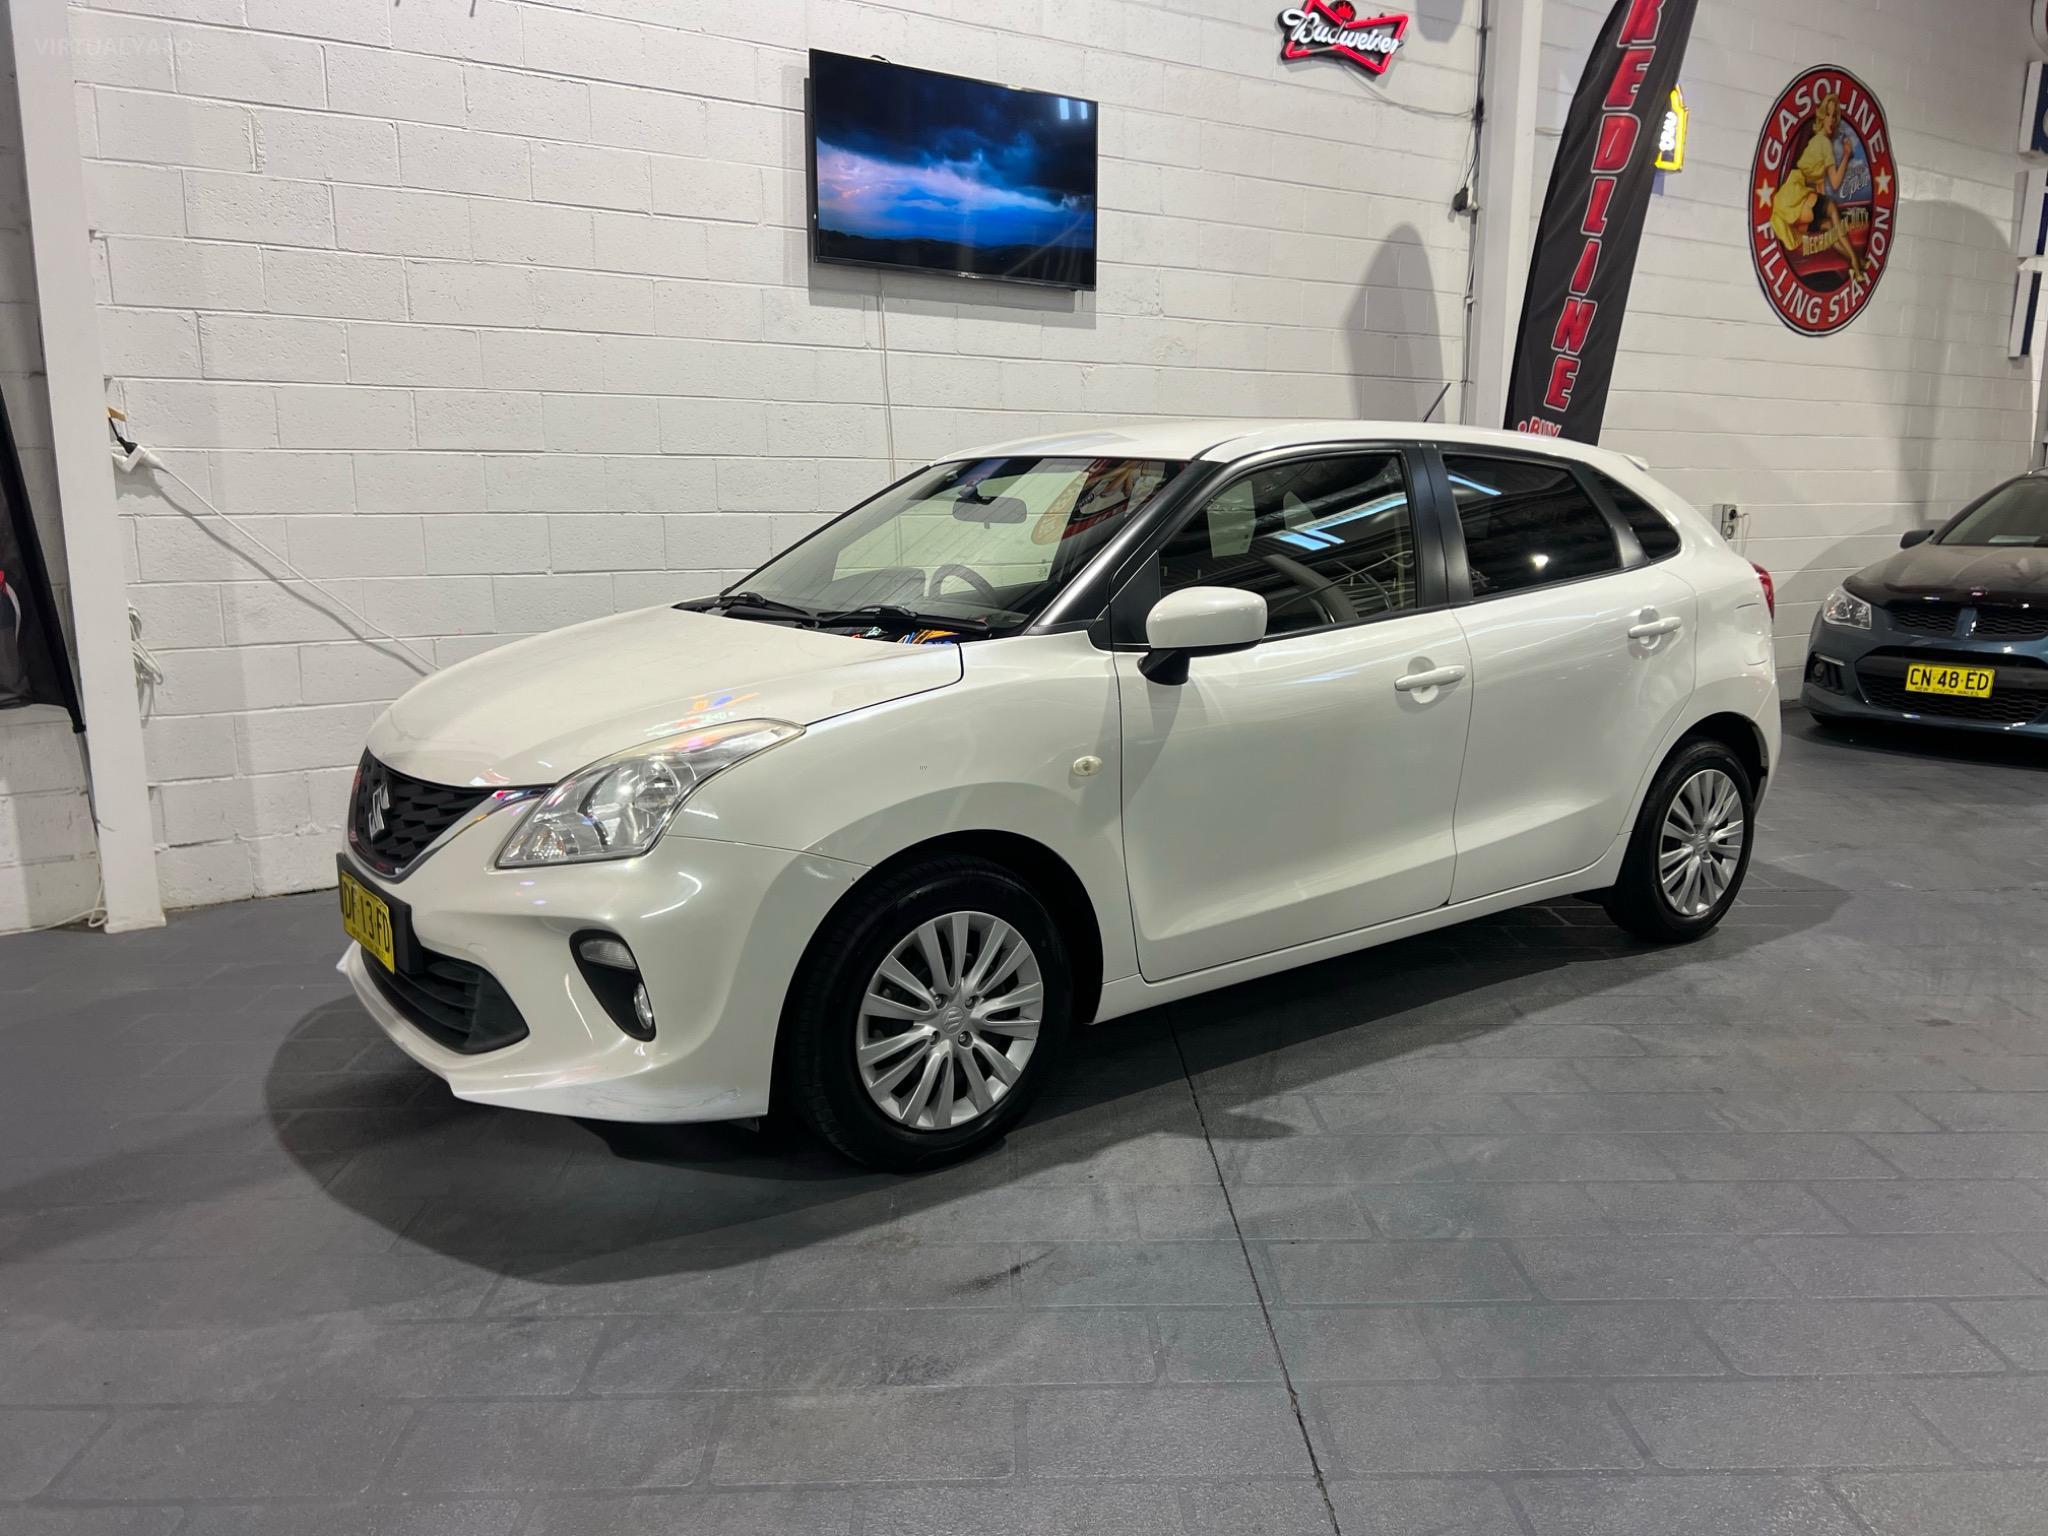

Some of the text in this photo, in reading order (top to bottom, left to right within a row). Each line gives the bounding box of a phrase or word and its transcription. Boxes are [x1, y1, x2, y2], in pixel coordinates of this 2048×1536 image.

[1282, 8, 1401, 54] Budweiser
[1764, 78, 1885, 170] GASOLINE
[1544, 0, 1665, 412] REDLINE
[1757, 222, 1822, 324] FILLING
[1910, 668, 1989, 691] CN 48 ED
